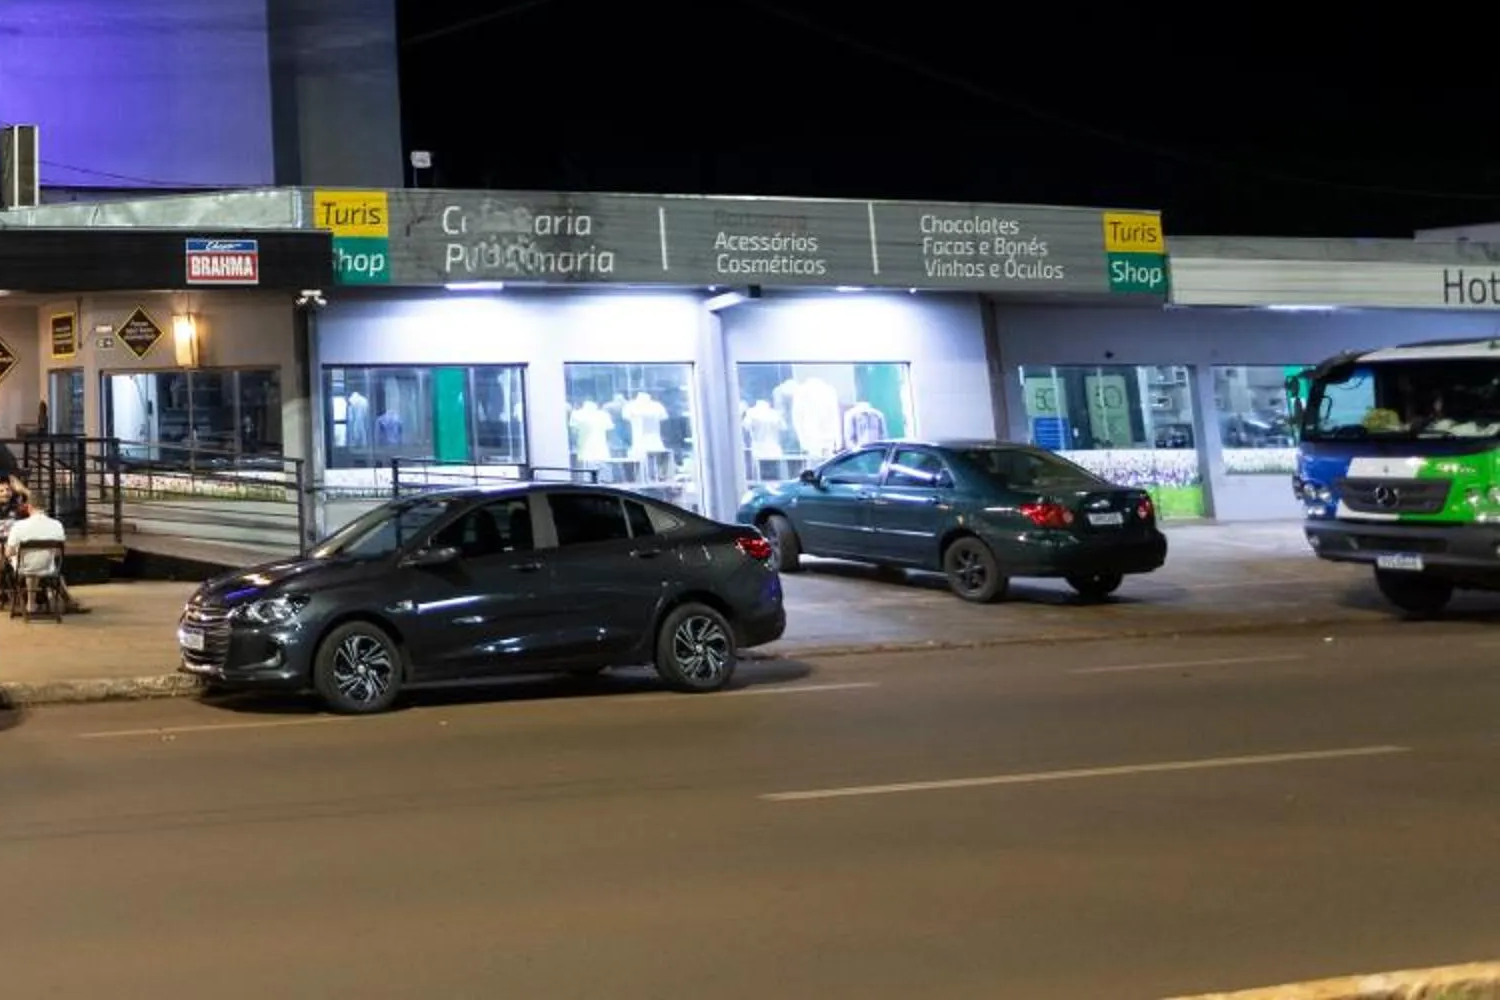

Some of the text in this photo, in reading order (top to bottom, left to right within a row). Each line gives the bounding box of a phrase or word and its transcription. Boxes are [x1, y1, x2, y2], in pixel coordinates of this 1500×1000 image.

[320, 201, 382, 226] Turis
[920, 215, 1020, 235] Chocolates
[1107, 221, 1158, 243] Turis
[714, 231, 819, 252] Acessórios
[923, 237, 1048, 258] Facas e Bonés
[191, 255, 254, 277] BRAHMA
[332, 248, 385, 277] hop
[717, 253, 827, 276] Cosméticos
[924, 254, 1065, 280] Vinhos e Óculos
[1111, 261, 1163, 287] Shop
